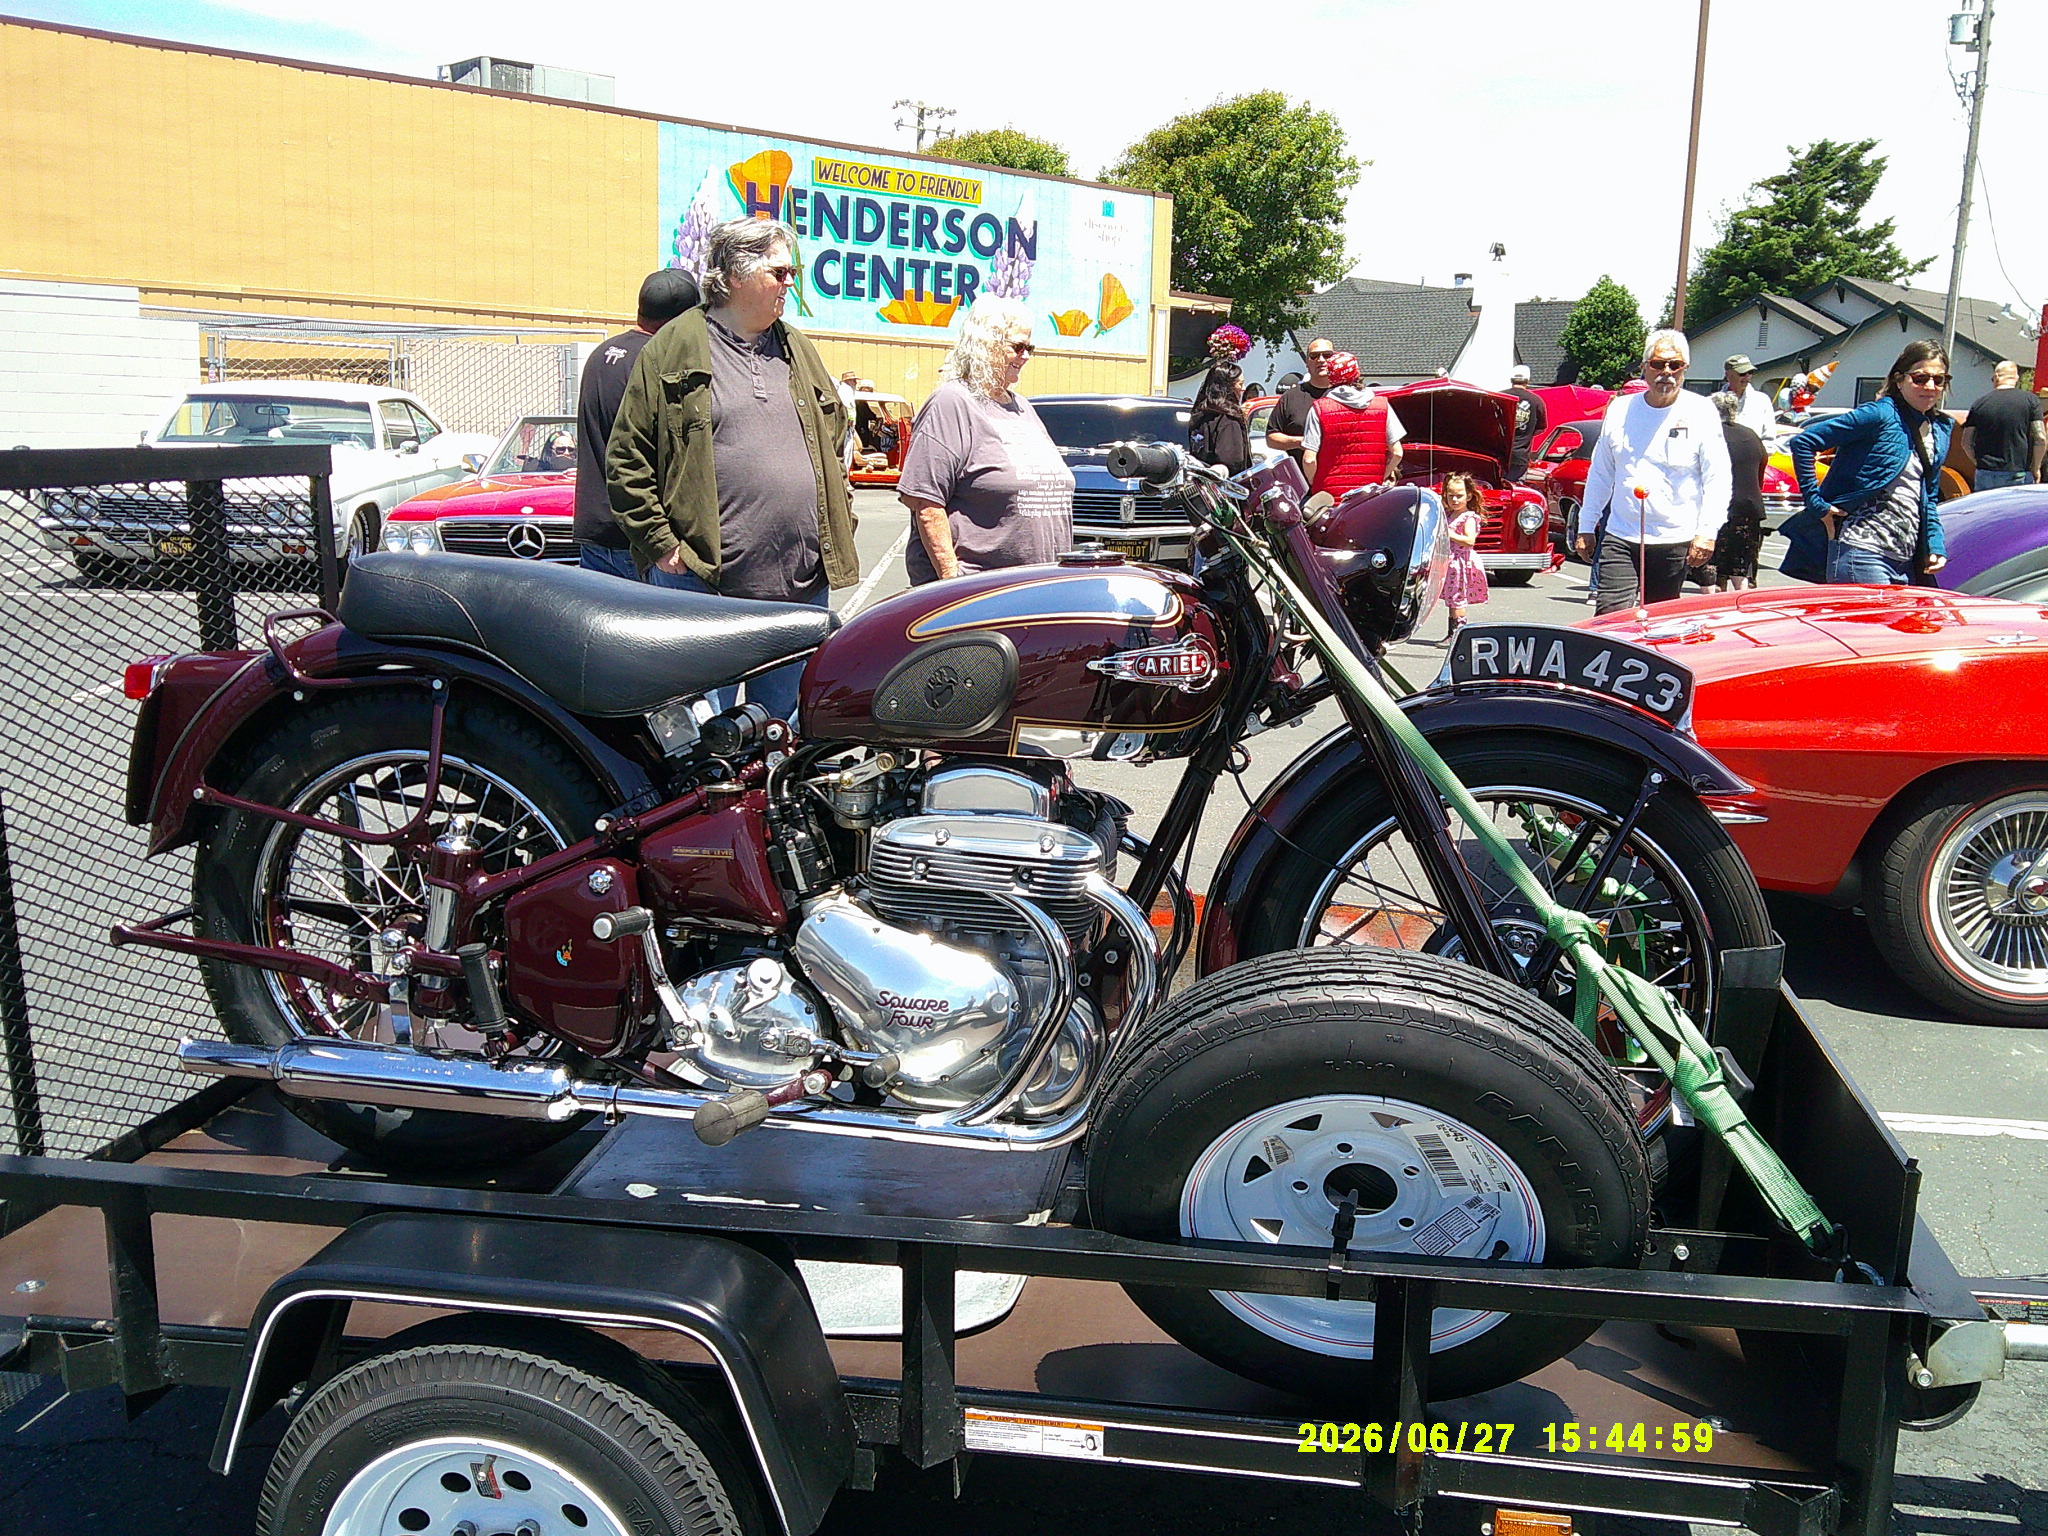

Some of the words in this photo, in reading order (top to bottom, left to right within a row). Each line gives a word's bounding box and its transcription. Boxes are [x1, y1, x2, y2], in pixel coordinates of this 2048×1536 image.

[818, 160, 891, 189] WELCOME
[896, 172, 916, 192] TO
[919, 175, 980, 201] FRIENDLY
[746, 181, 1037, 261] HENDERSON
[814, 249, 980, 307] CENTER
[1145, 655, 1203, 675] ARIEL
[1471, 636, 1567, 680] RWA
[1582, 650, 1683, 713] 423
